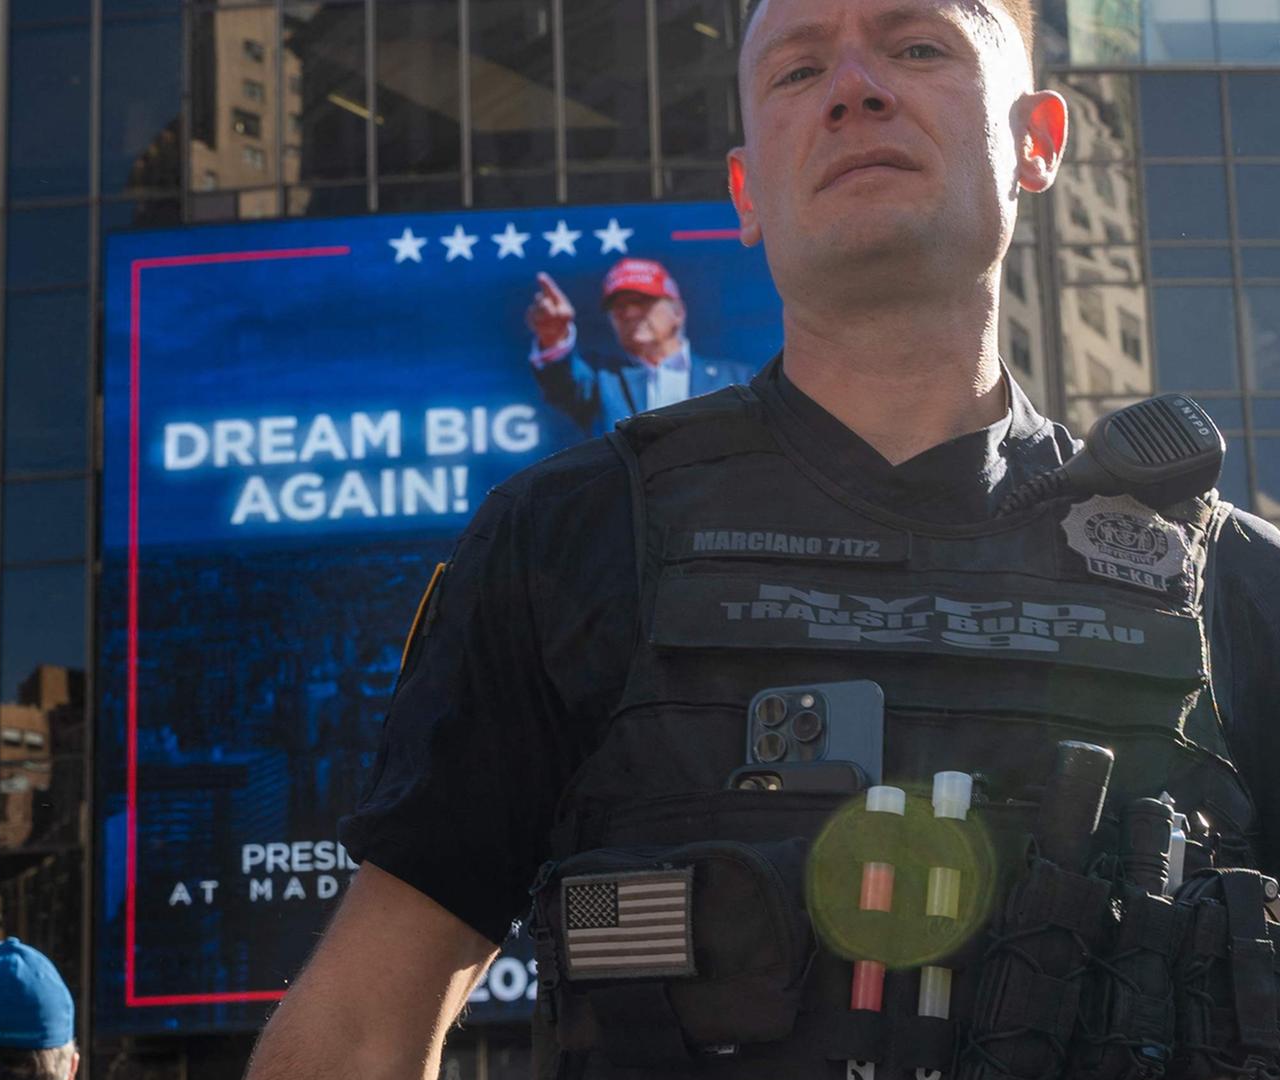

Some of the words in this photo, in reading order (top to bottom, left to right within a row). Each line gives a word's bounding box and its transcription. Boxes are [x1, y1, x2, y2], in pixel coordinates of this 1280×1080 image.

[163, 410, 402, 471] DREAM
[425, 404, 540, 456] BIG
[1180, 406, 1210, 436] NYPD
[230, 465, 469, 525] AGAIN!
[693, 531, 822, 555] MARCIANO
[827, 537, 880, 557] 7172
[759, 583, 1106, 621] NYPD
[720, 601, 935, 628] TRANSIT
[947, 615, 1145, 645] BUREAU
[808, 622, 1060, 652] K9
[169, 880, 219, 906] AT
[249, 875, 340, 902] MAD
